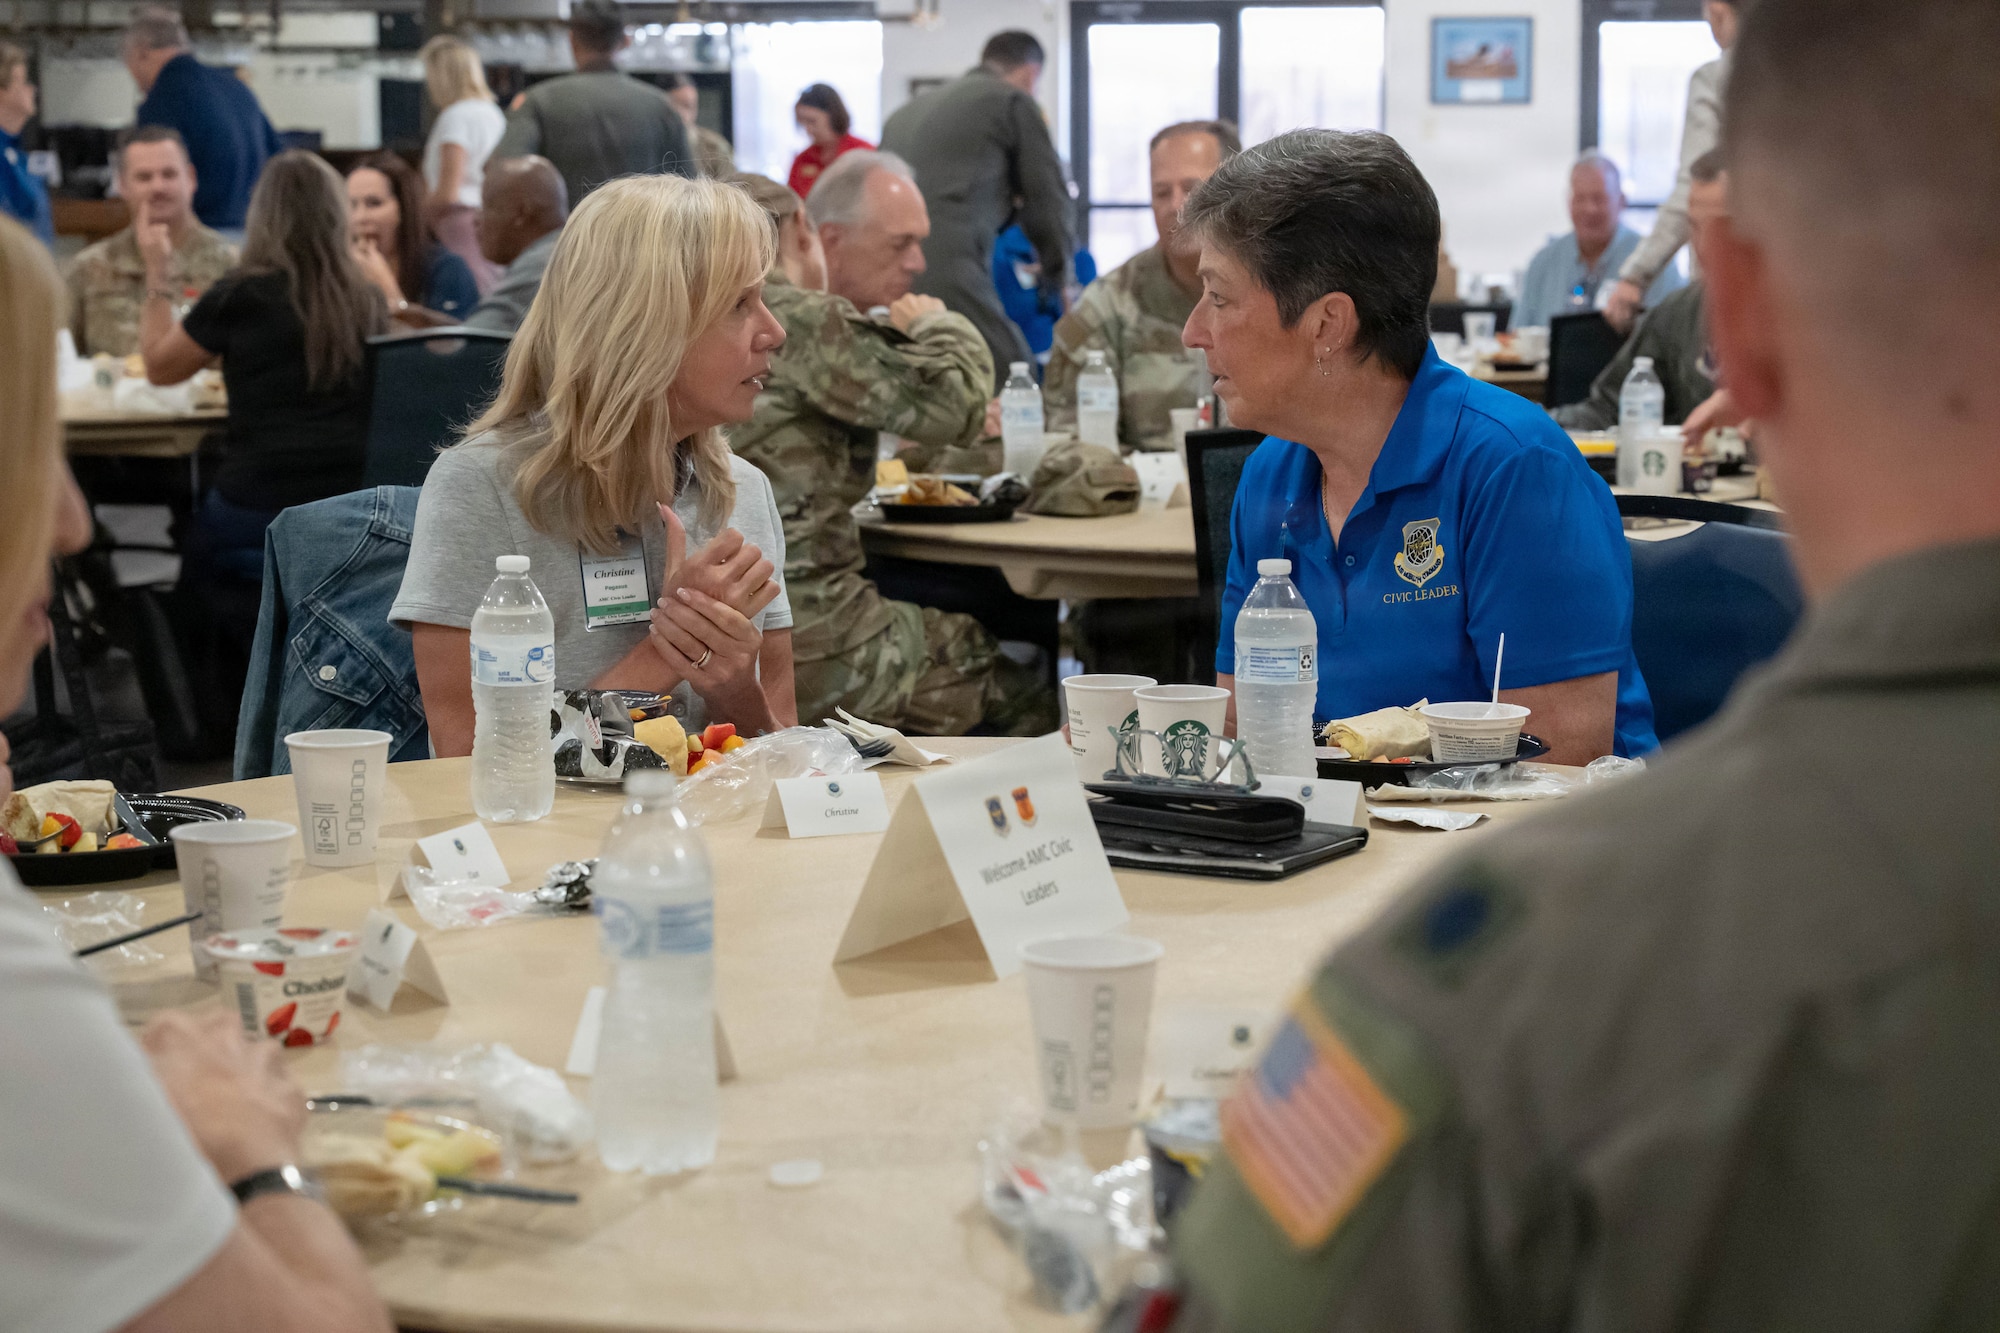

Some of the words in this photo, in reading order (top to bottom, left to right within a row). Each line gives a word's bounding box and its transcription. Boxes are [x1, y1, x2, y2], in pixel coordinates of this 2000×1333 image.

[594, 568, 636, 580] Christine
[1383, 591, 1412, 604] CIVIC
[1415, 585, 1460, 601] LEADER
[824, 807, 859, 818] Christine
[980, 857, 1027, 885] Welcome
[1026, 843, 1051, 866] AMC
[1050, 837, 1074, 858] Civic
[1020, 880, 1060, 906] Leaders
